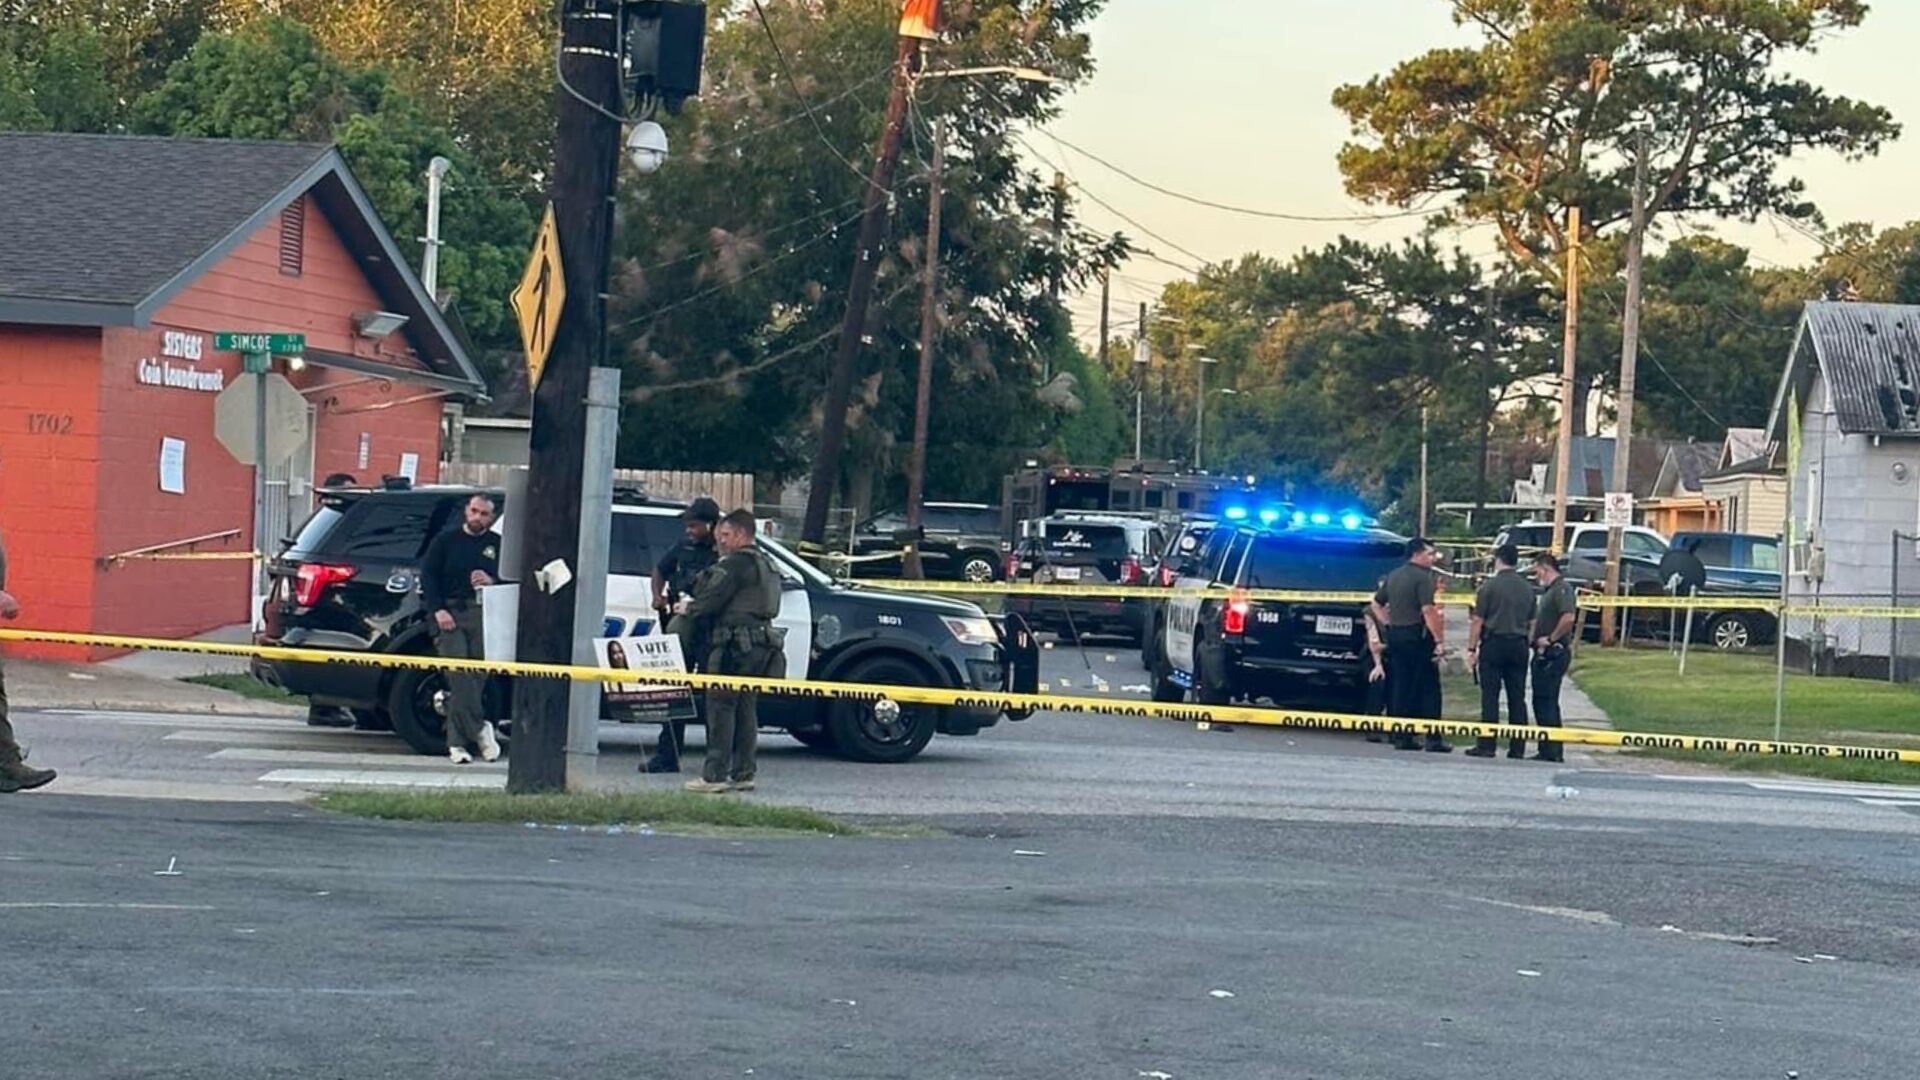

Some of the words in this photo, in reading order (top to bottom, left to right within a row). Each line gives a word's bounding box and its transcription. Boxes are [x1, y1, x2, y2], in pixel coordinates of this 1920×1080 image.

[161, 331, 203, 360] SISTERS
[215, 336, 220, 347] E
[230, 335, 272, 350] SIMCOE
[26, 413, 74, 435] 1702
[636, 640, 671, 654] VOTE
